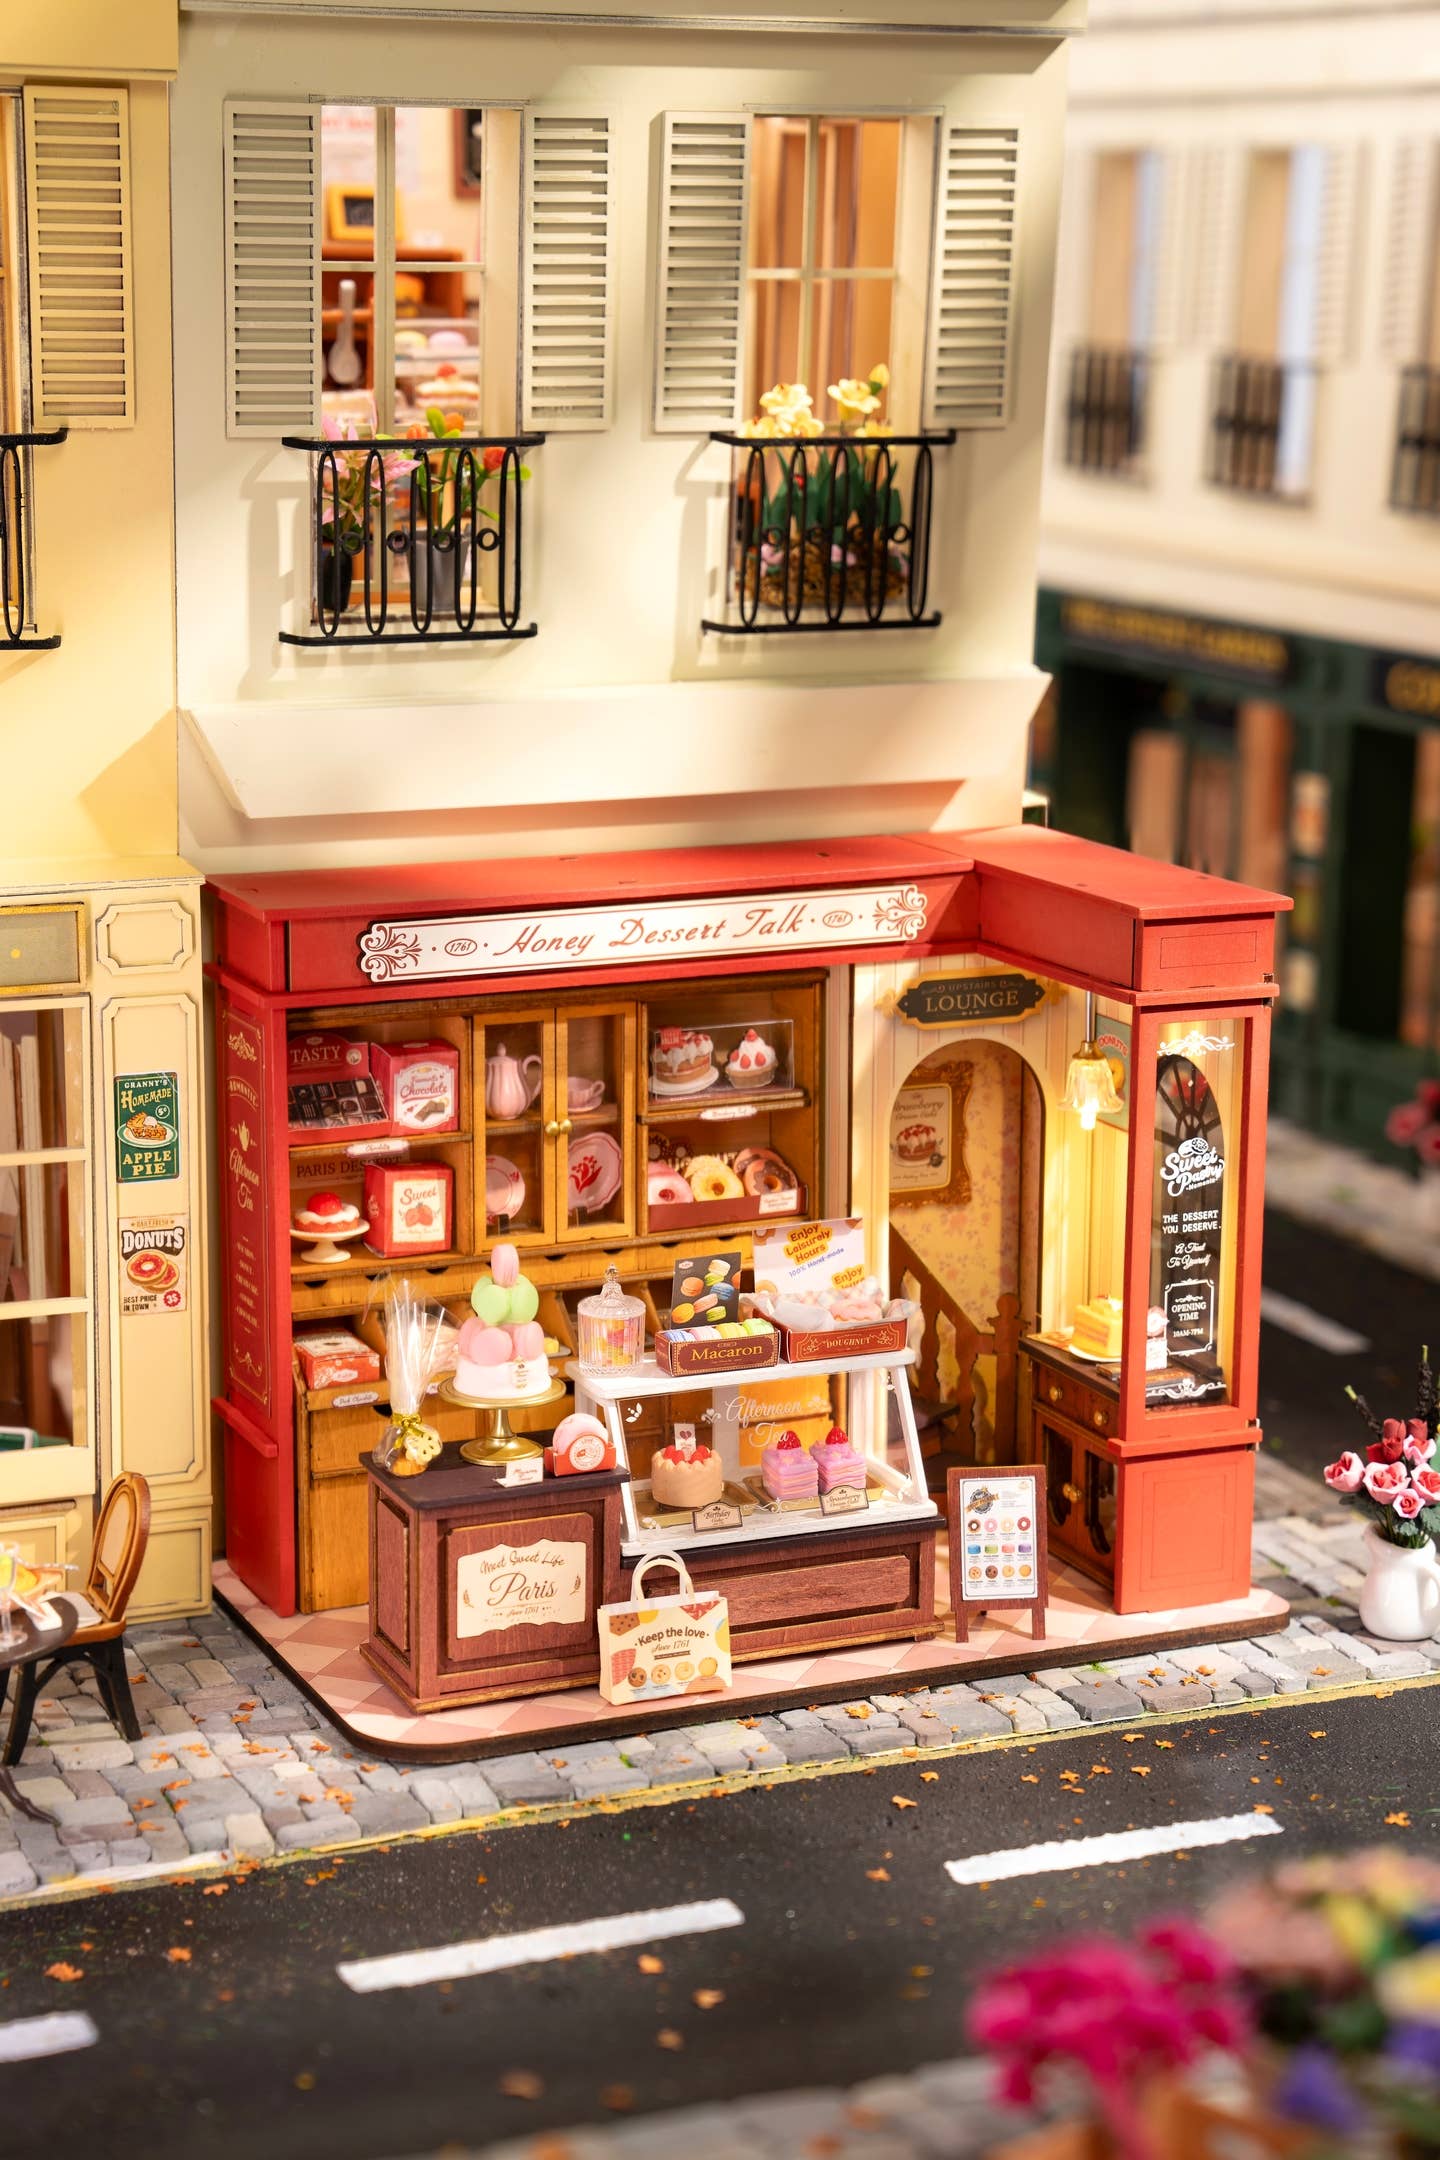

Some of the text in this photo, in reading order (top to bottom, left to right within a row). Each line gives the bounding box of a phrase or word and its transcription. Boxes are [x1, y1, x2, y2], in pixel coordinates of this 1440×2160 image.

[449, 903, 848, 957] 1761 Honey Dessert Talk 1761
[948, 980, 996, 991] UPSTAIRS
[926, 990, 1019, 1013] LOUNGE
[289, 1045, 341, 1063] TASTY
[124, 1079, 168, 1089] GRANNY'S
[400, 1080, 448, 1099] Chocolate
[122, 1150, 172, 1165] APPLE
[1160, 1146, 1219, 1181] Sweet
[132, 1162, 166, 1176] PIE
[296, 1162, 336, 1178] PARIS
[1167, 1159, 1225, 1197] Pastry
[400, 1186, 437, 1206] Sweet
[1162, 1209, 1219, 1223] THE DESSERT
[790, 1224, 819, 1242] Enjoy
[1162, 1221, 1221, 1234] YOU DESERVE.
[122, 1227, 184, 1254] DONUTS
[786, 1230, 830, 1256] Leisurely
[795, 1244, 826, 1263] Hours
[834, 1266, 863, 1285] Enjoy
[123, 1294, 157, 1304] BEST PRICE
[123, 1303, 150, 1312] IN TOWN
[1171, 1302, 1206, 1313] OPENING
[1178, 1312, 1199, 1322] TIME
[1172, 1327, 1204, 1338] 10AM-7PM
[826, 1336, 872, 1349] DOUGHNUT
[690, 1345, 763, 1361] Macaron
[725, 1396, 802, 1429] Afternoon
[748, 1422, 789, 1448] Tea
[509, 1549, 540, 1567] Sweet
[540, 1551, 566, 1568] Life
[486, 1571, 558, 1607] Paris
[638, 1626, 706, 1647] Keep the love
[673, 1639, 690, 1650] 1761
